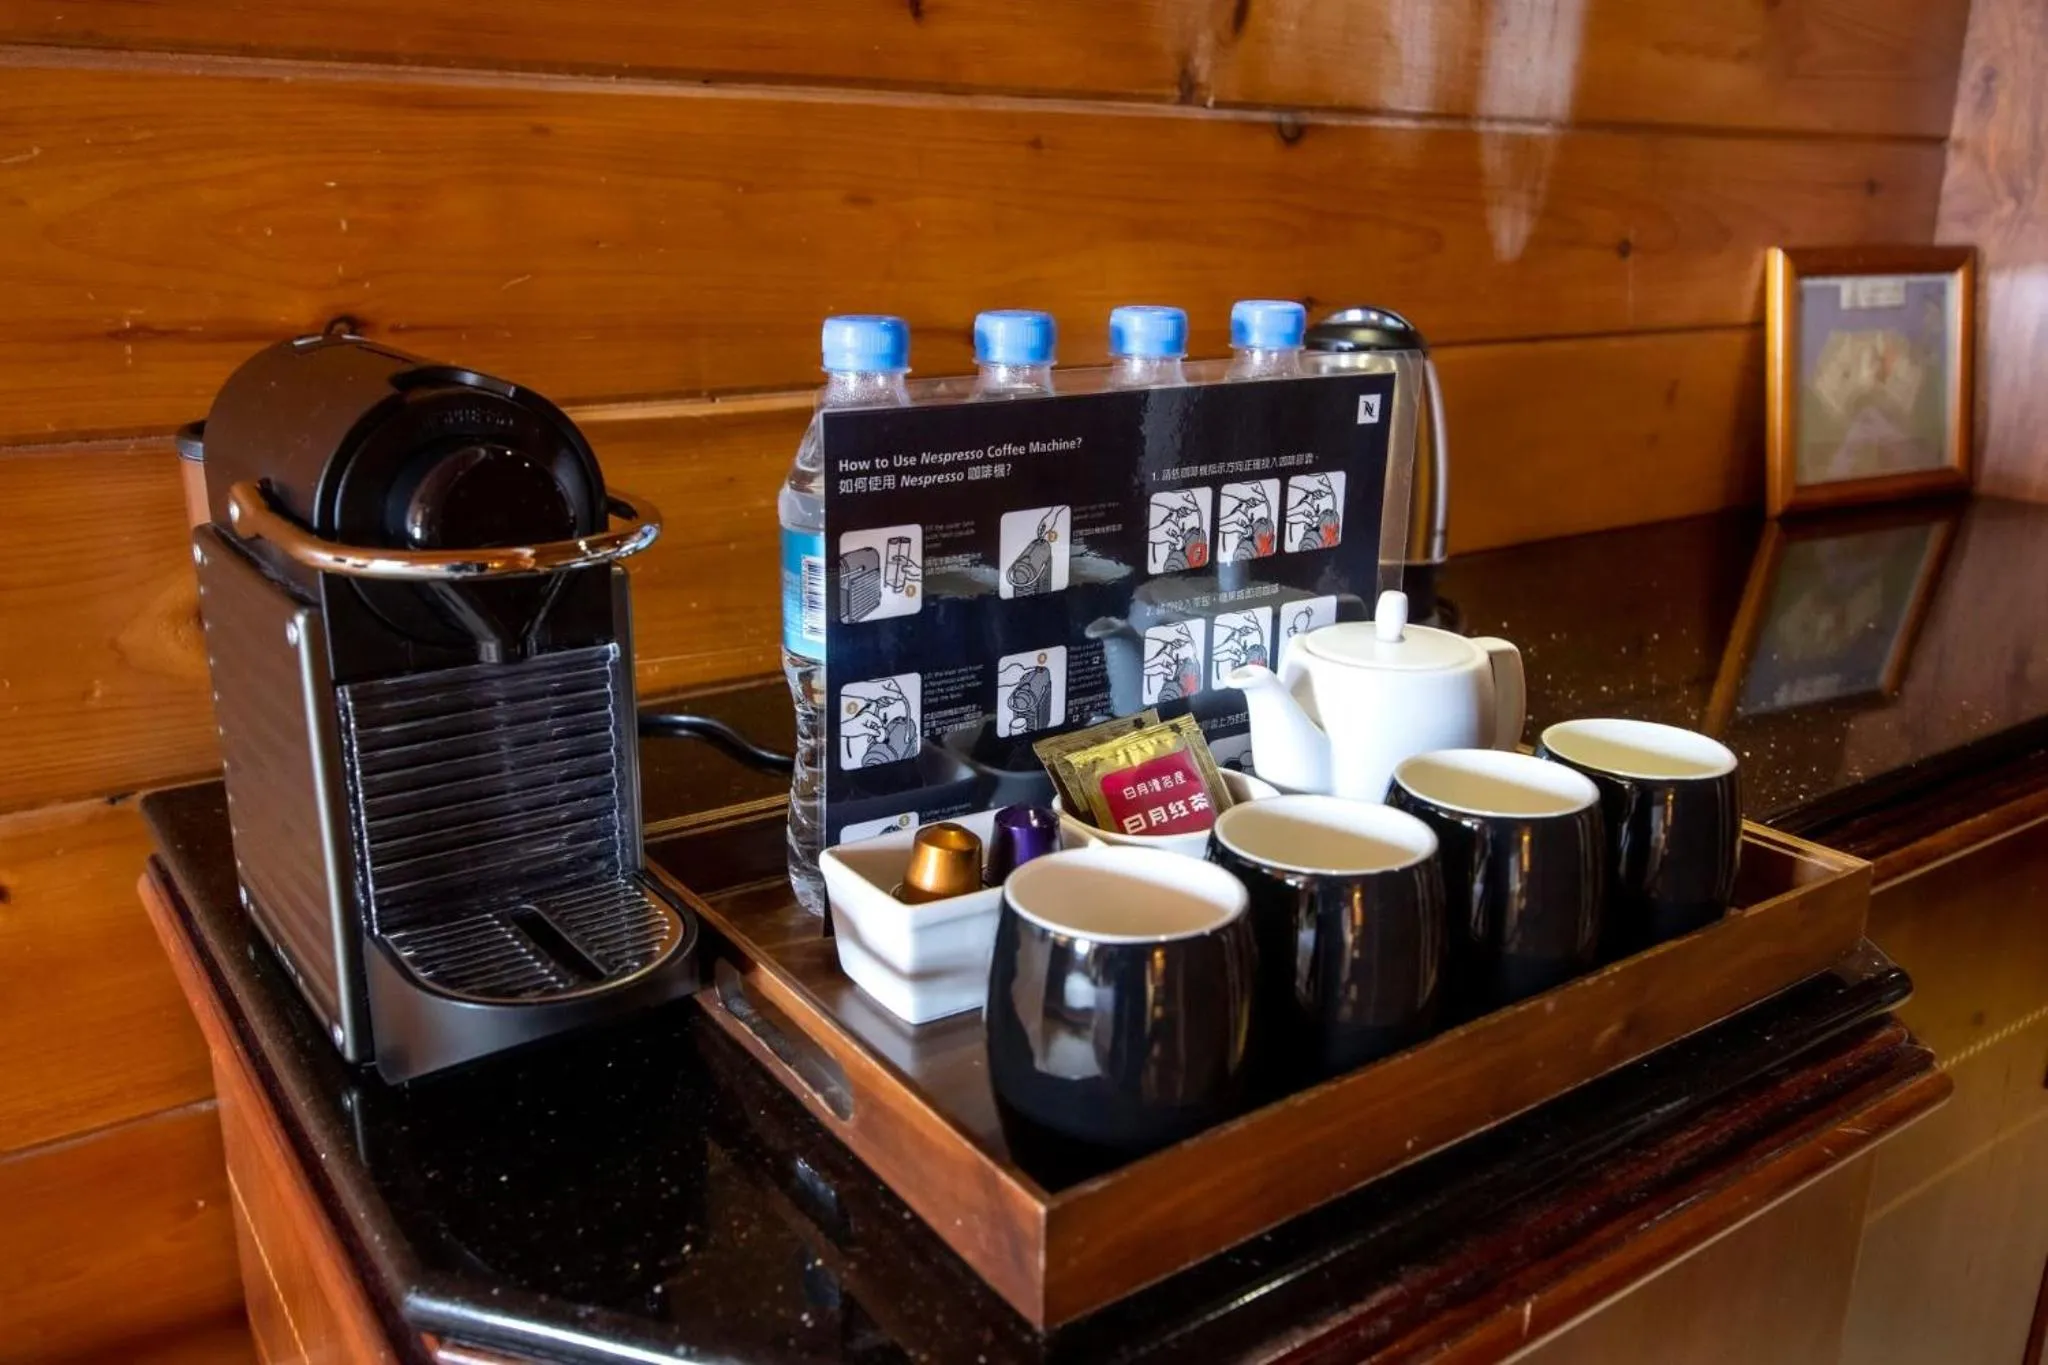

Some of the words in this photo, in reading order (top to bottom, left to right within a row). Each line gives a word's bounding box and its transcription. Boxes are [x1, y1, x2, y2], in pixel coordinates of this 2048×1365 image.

[839, 459, 870, 472] How
[875, 458, 889, 469] to
[893, 455, 917, 467] Use
[920, 449, 984, 465] Nespresso
[987, 444, 1026, 457] Coffee
[1029, 437, 1083, 453] Machine?
[839, 474, 896, 494] 如何使用
[900, 471, 965, 489] Nespresso
